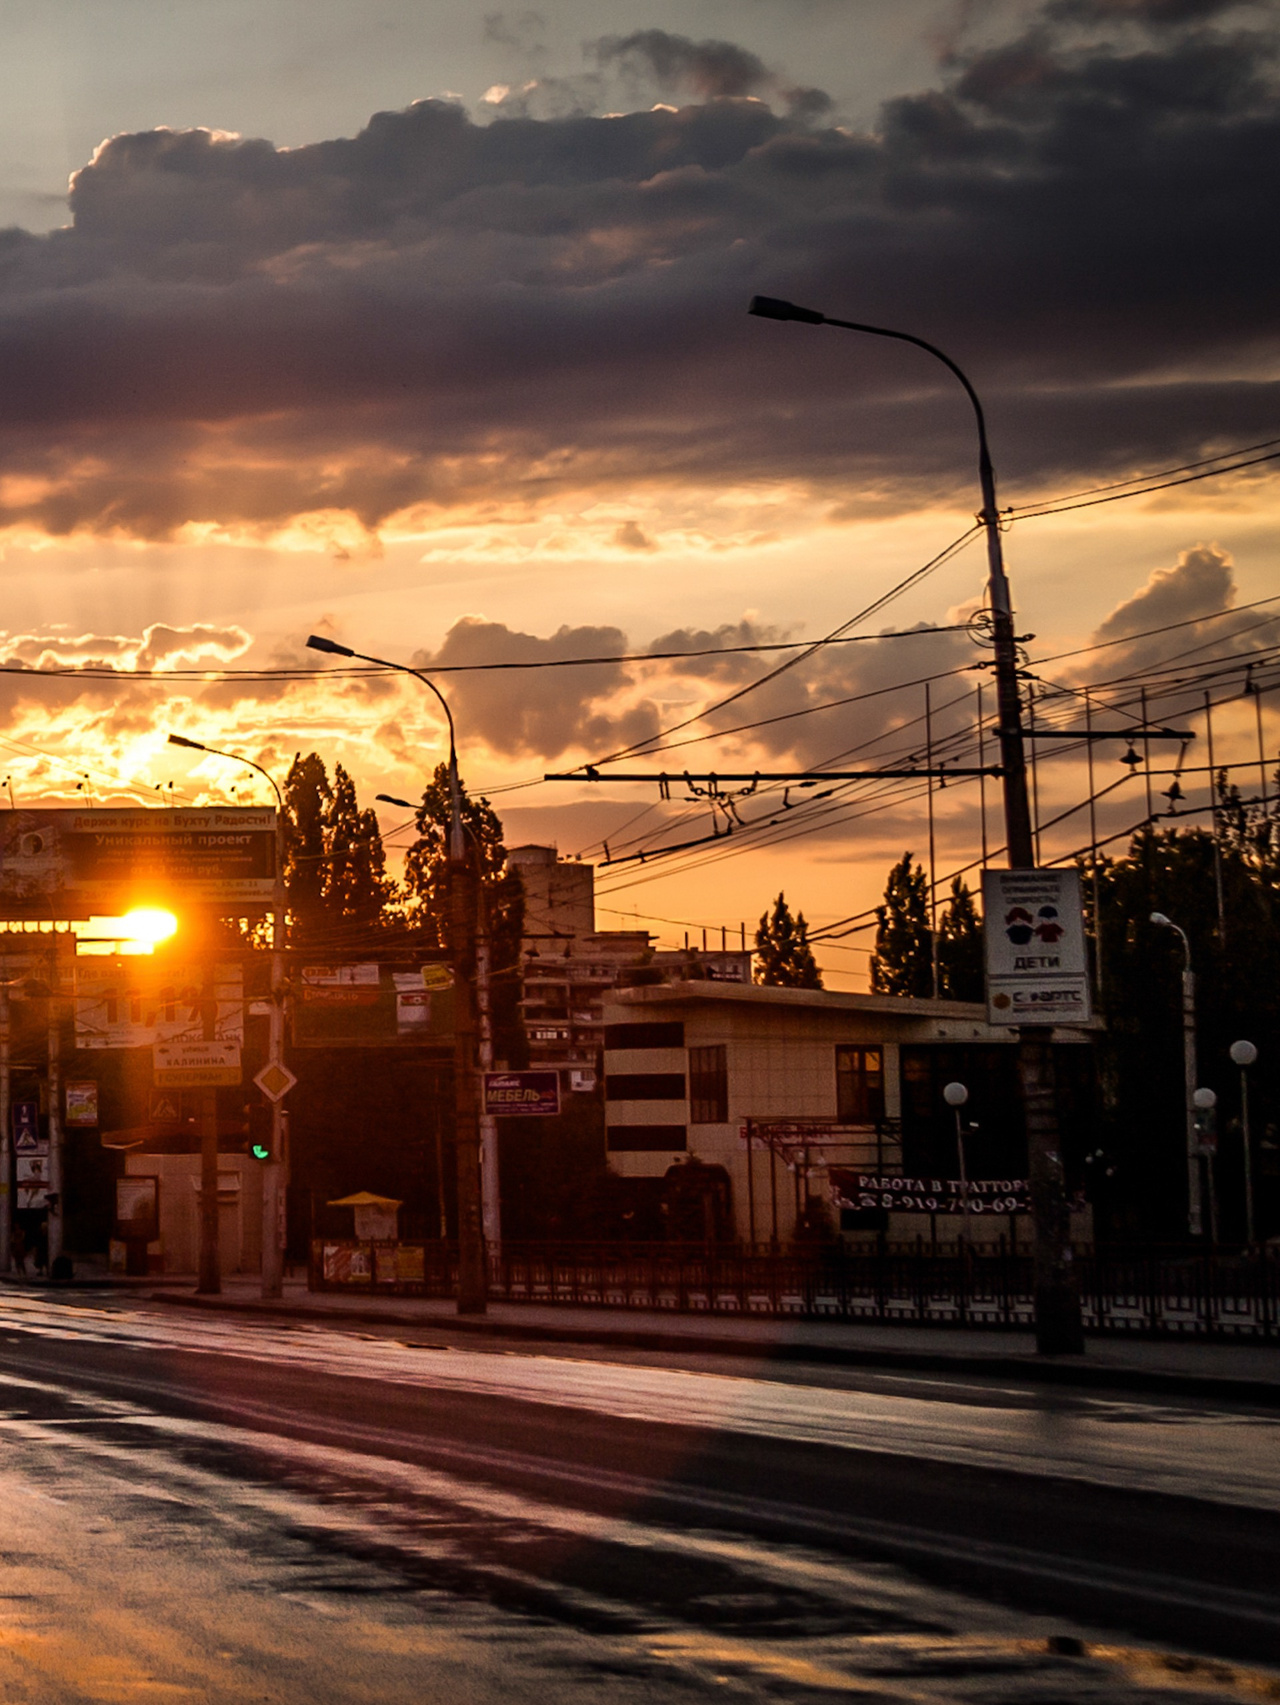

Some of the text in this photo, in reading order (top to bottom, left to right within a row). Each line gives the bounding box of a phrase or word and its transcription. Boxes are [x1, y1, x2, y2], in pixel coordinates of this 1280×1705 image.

[73, 815, 271, 828] Держи курс на Бухту Радости!
[95, 833, 252, 847] Уникальный проект
[130, 866, 142, 874] от
[198, 864, 223, 876] руб.
[1014, 956, 1060, 970] ДЕТИ
[166, 1057, 226, 1066] КАЛИНИНА
[487, 1089, 541, 1102] МЕБЕЛЬ
[859, 1175, 926, 1192] РАБОТА
[932, 1180, 943, 1192] В
